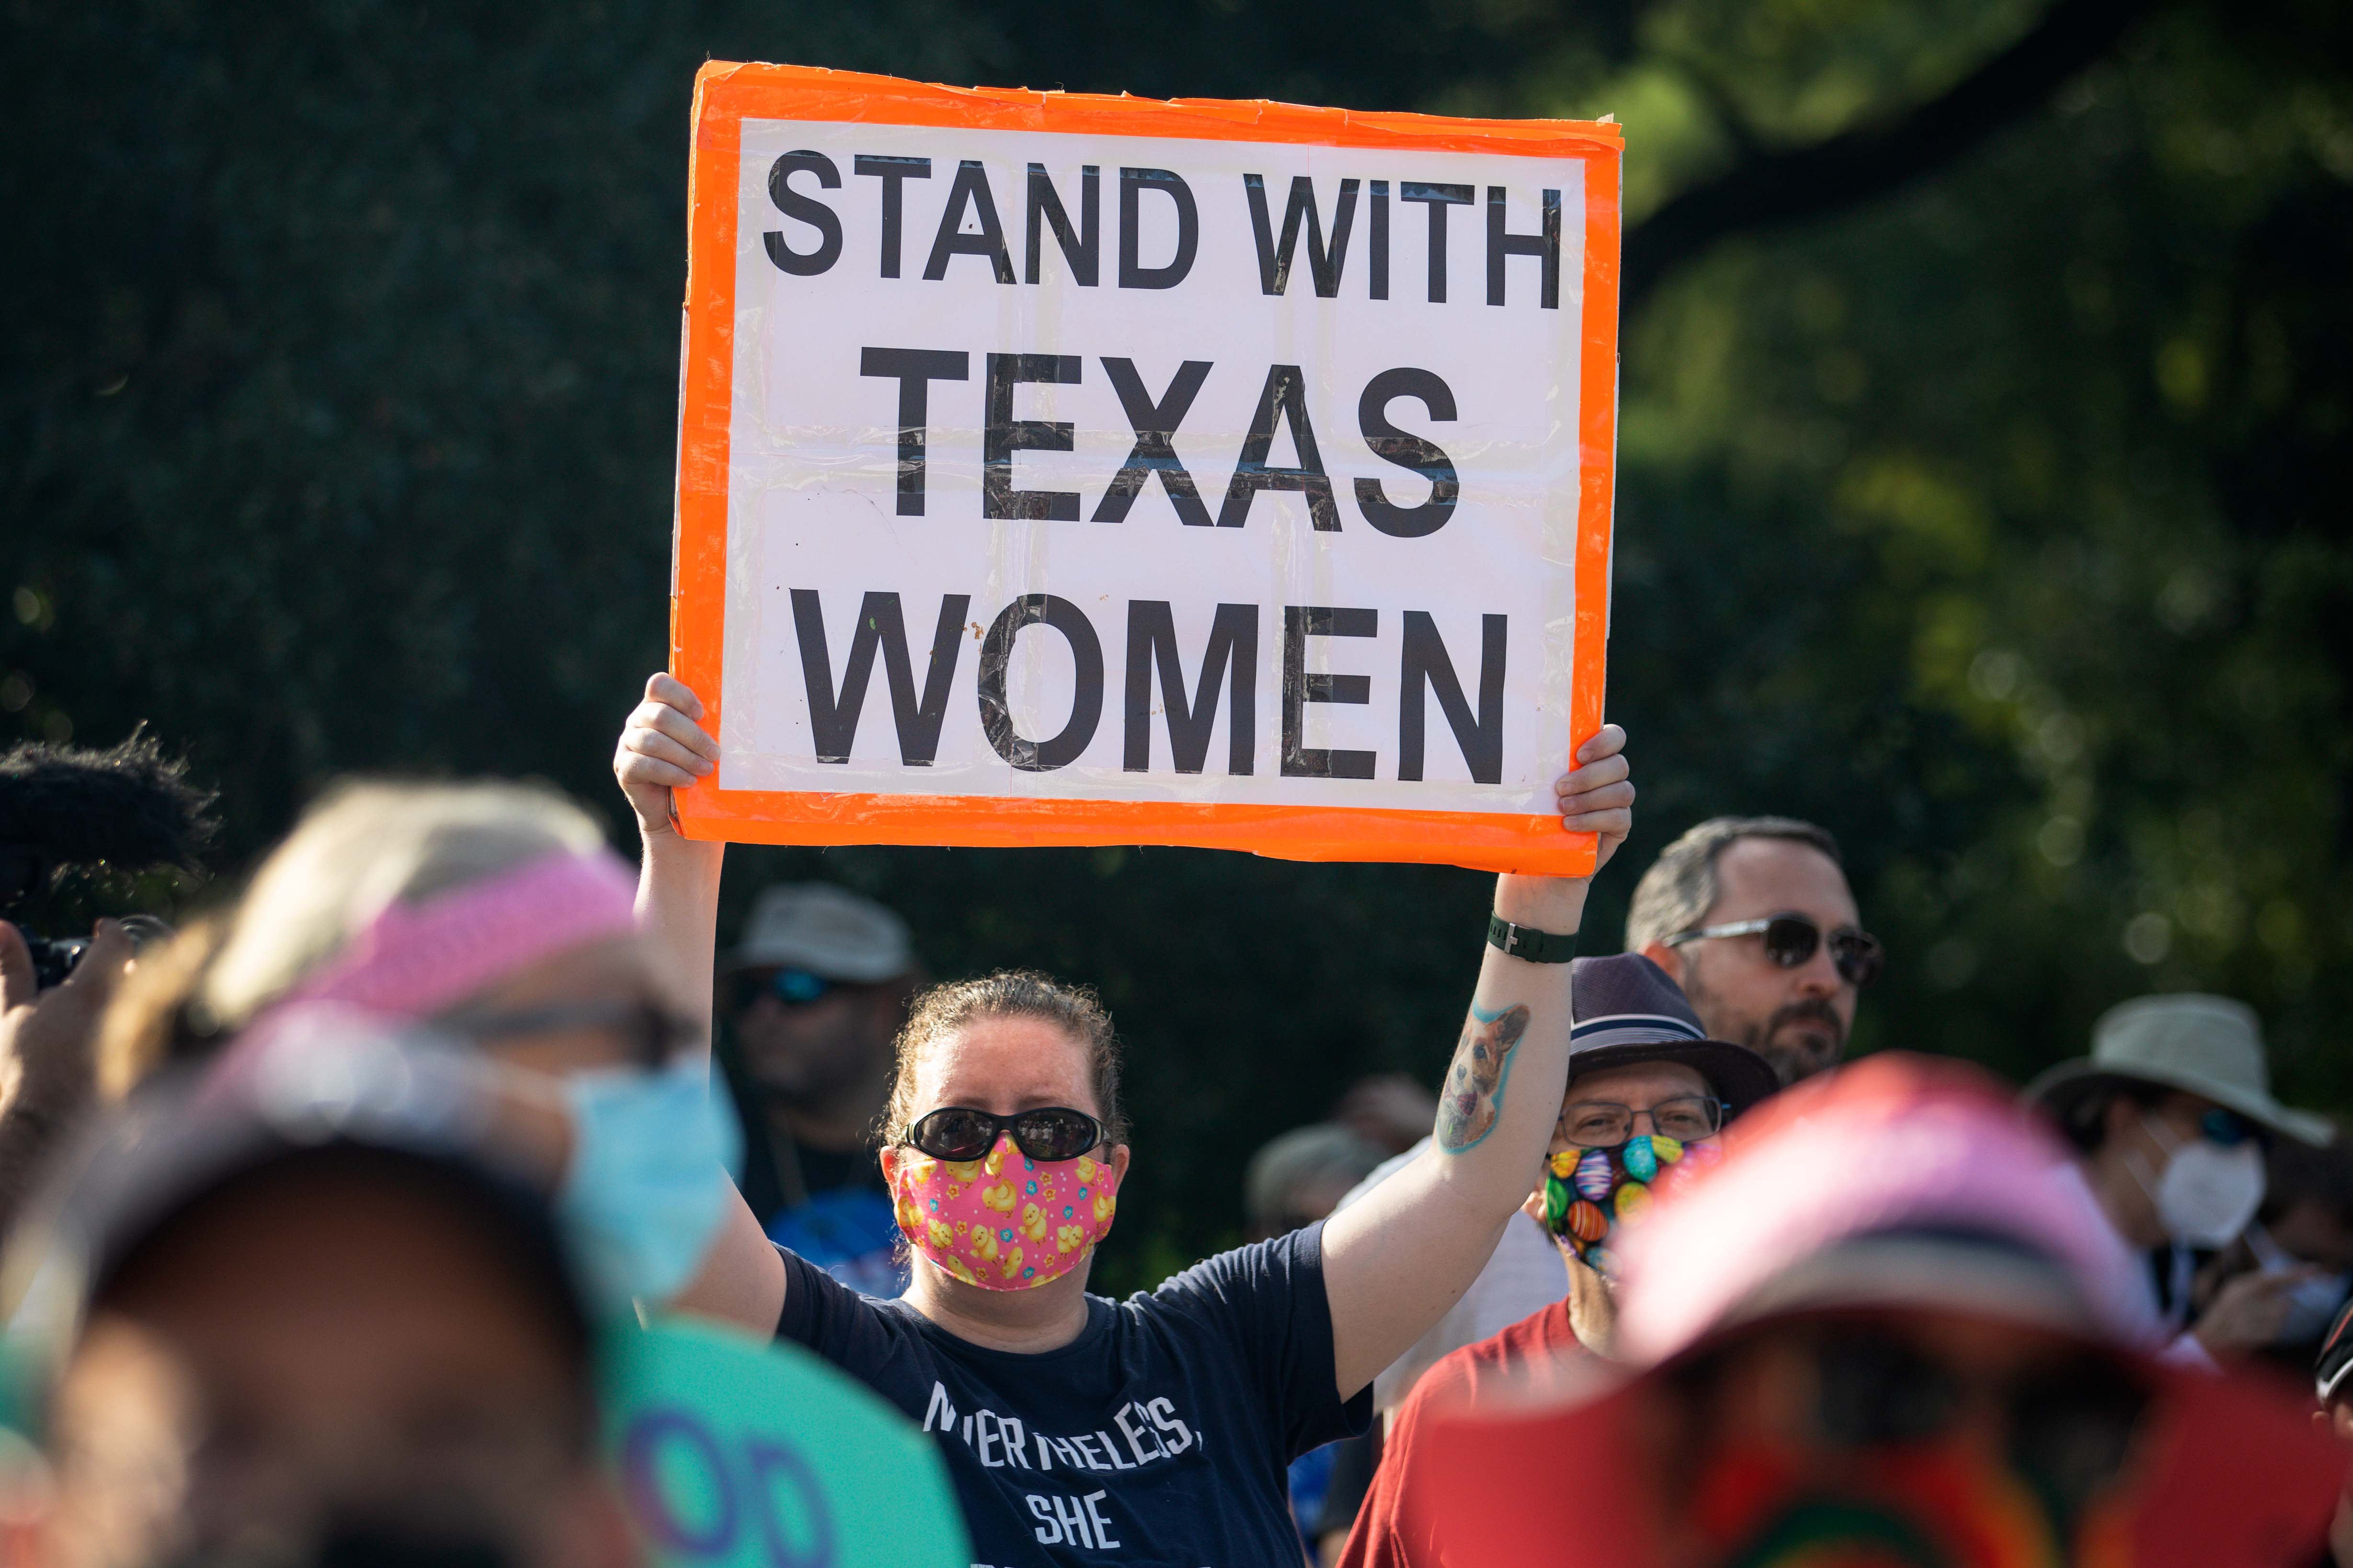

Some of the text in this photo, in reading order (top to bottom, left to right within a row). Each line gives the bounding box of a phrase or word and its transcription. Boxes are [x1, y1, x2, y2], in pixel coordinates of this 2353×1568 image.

[762, 149, 1562, 309] STAND WITH
[859, 346, 1460, 538] TEXAS
[788, 587, 1508, 785] WOMEN
[1025, 1489, 1121, 1549] SHE
